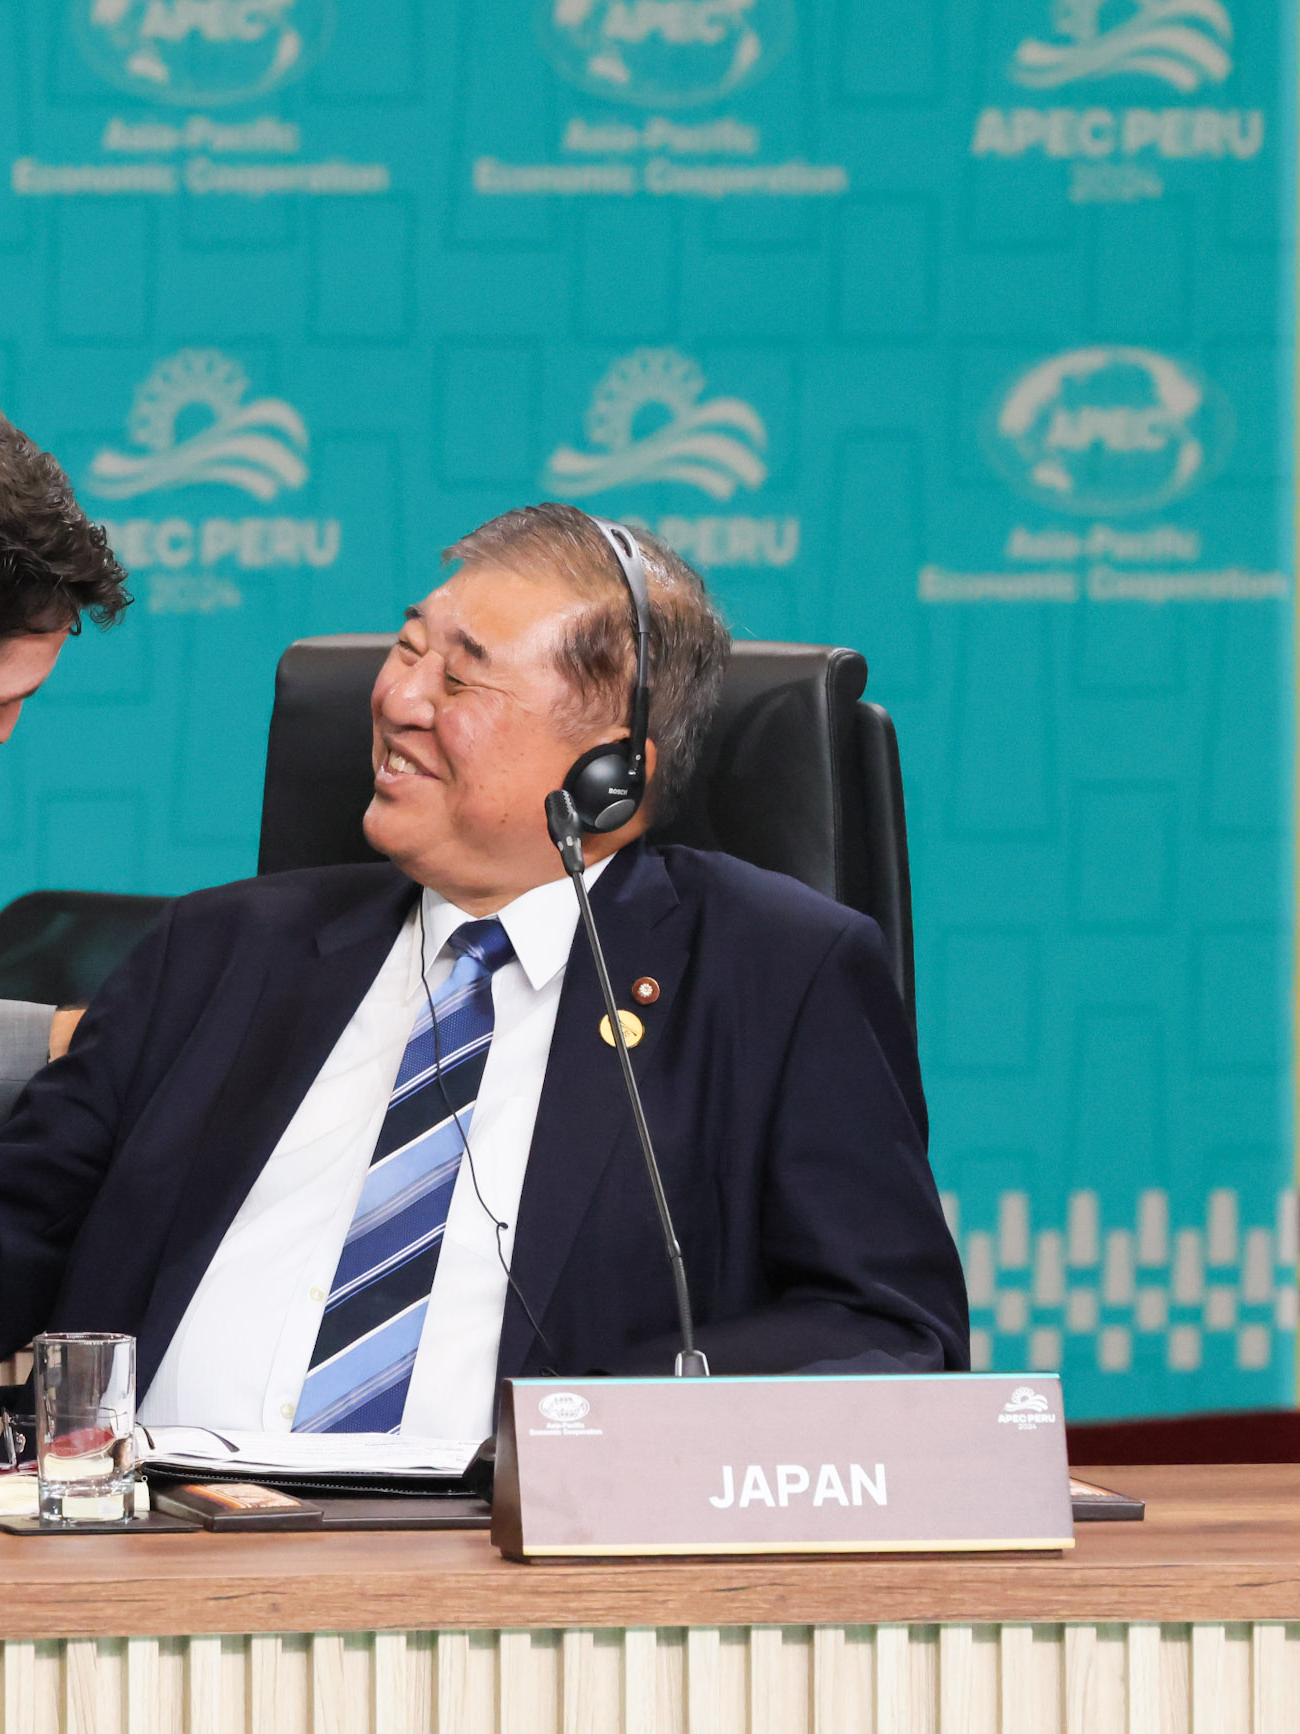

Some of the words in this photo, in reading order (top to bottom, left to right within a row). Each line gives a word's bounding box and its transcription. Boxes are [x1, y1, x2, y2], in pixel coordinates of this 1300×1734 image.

[104, 115, 299, 153] Asia-Pacific
[562, 117, 758, 154] Asia-Pacific
[972, 107, 1115, 157] APEC
[1124, 107, 1262, 158] PERU
[12, 157, 178, 195] Economic
[185, 157, 389, 196] Cooperation
[473, 157, 637, 195] Economic
[645, 157, 849, 197] Cooperation
[1049, 408, 1166, 449] APEC
[202, 518, 341, 568] PERU
[1007, 525, 1197, 561] Asia-Pacific
[918, 565, 1076, 601] Economic
[1087, 566, 1288, 602] Cooperation
[608, 787, 628, 796] BOSCH
[998, 1413, 1025, 1423] APEC
[1027, 1413, 1056, 1423] PERU
[708, 1463, 888, 1509] JAPAN
